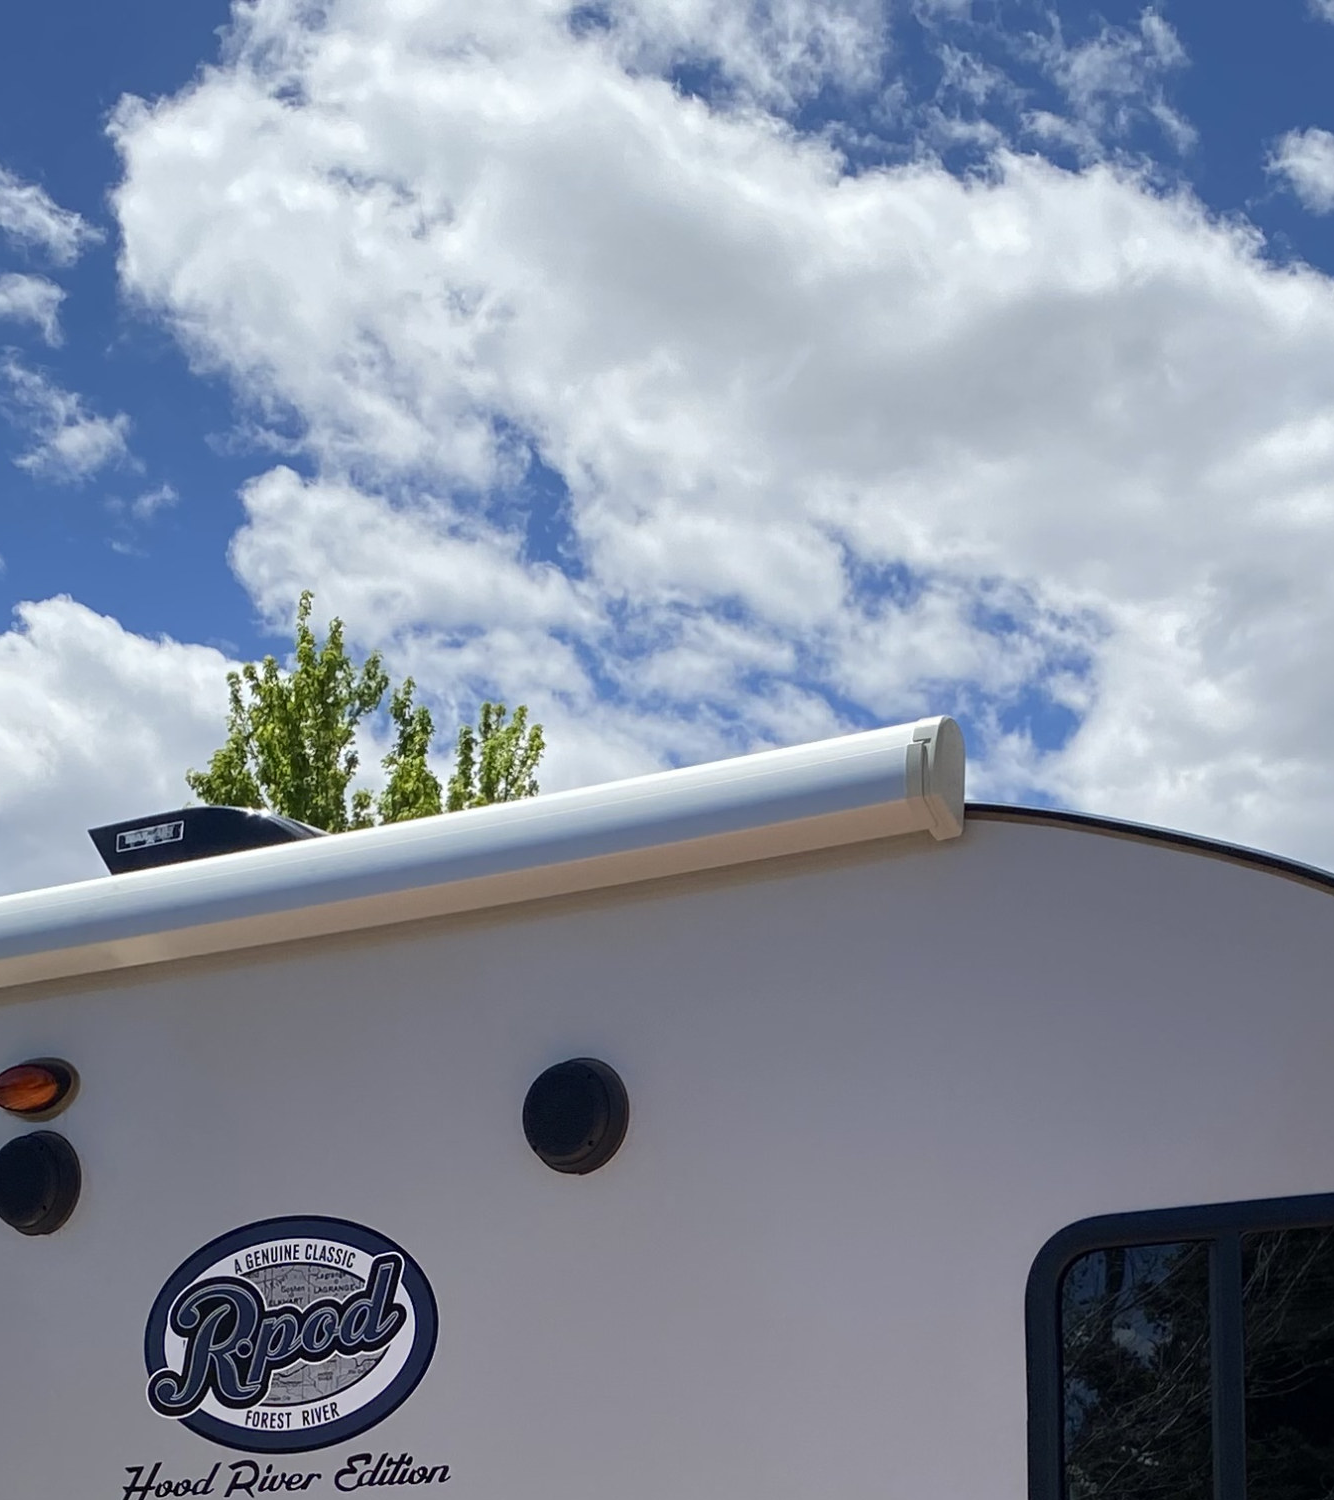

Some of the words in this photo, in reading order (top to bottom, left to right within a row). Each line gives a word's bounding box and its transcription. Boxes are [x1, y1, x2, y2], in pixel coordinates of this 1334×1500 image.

[234, 1259, 242, 1275] A
[245, 1244, 300, 1270] GENUINE
[305, 1243, 356, 1269] CLASSIC
[245, 1409, 292, 1429] FOREST
[302, 1402, 340, 1427] RIVER
[223, 1459, 322, 1499] River
[334, 1452, 451, 1492] Edition
